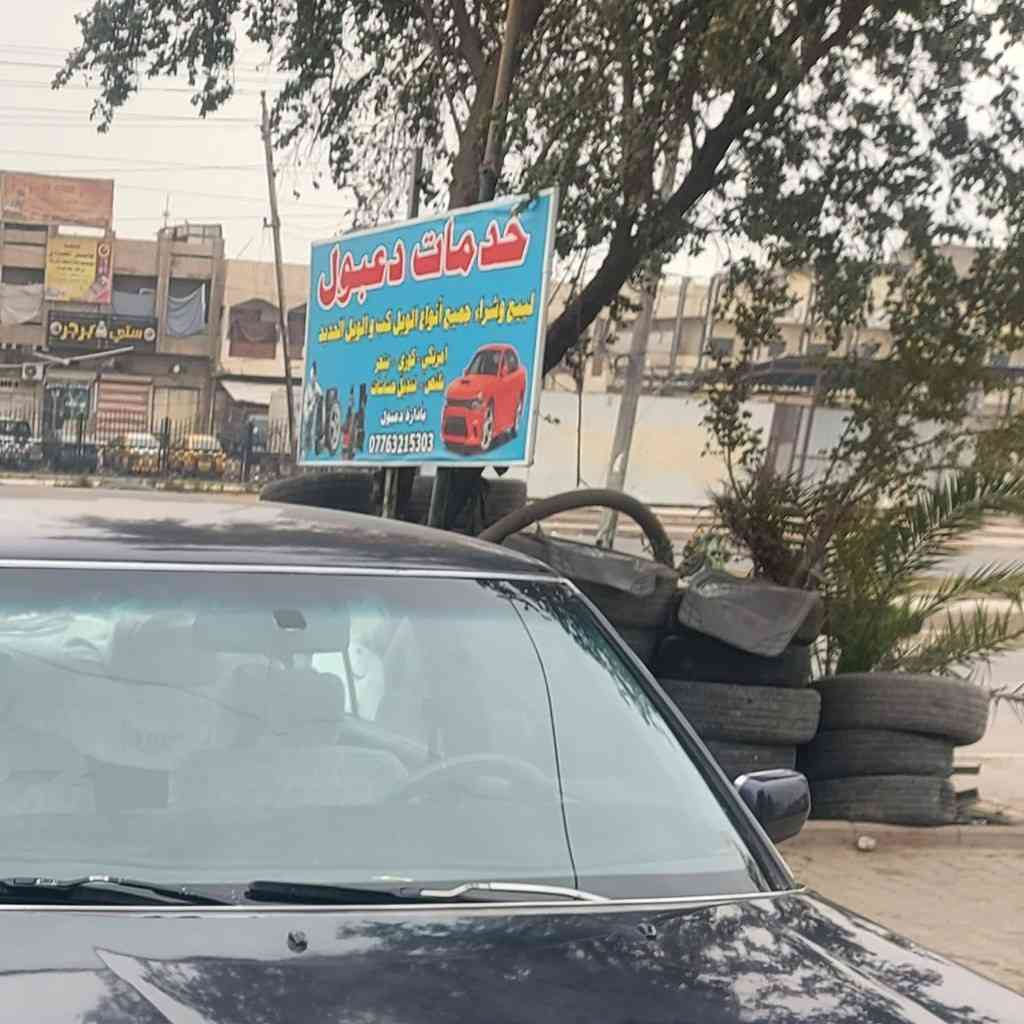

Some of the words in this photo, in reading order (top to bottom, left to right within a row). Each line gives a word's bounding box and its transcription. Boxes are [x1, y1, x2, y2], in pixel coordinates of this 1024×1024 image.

[318, 239, 405, 309] دعبول
[411, 214, 531, 281] خدمات
[368, 431, 434, 454] 07763215303
